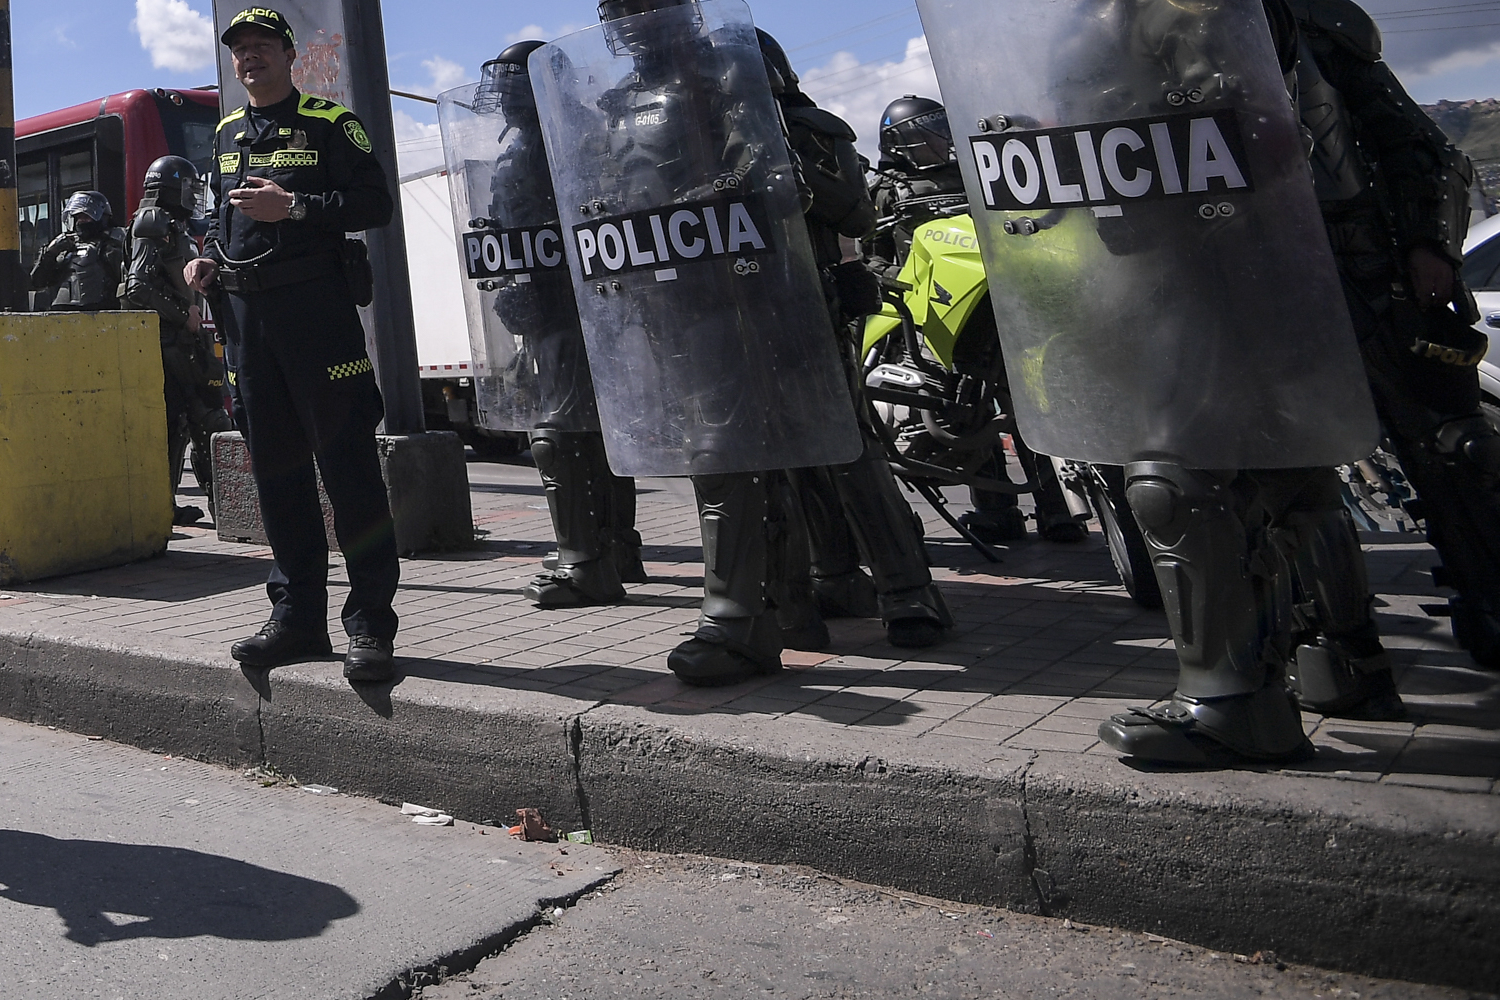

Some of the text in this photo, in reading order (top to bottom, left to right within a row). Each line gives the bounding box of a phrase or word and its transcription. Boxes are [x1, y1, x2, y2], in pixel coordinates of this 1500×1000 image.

[972, 117, 1247, 205] POLICIA
[467, 228, 562, 273] POLIC
[576, 202, 766, 276] POLICIA
[924, 229, 977, 250] POLICI
